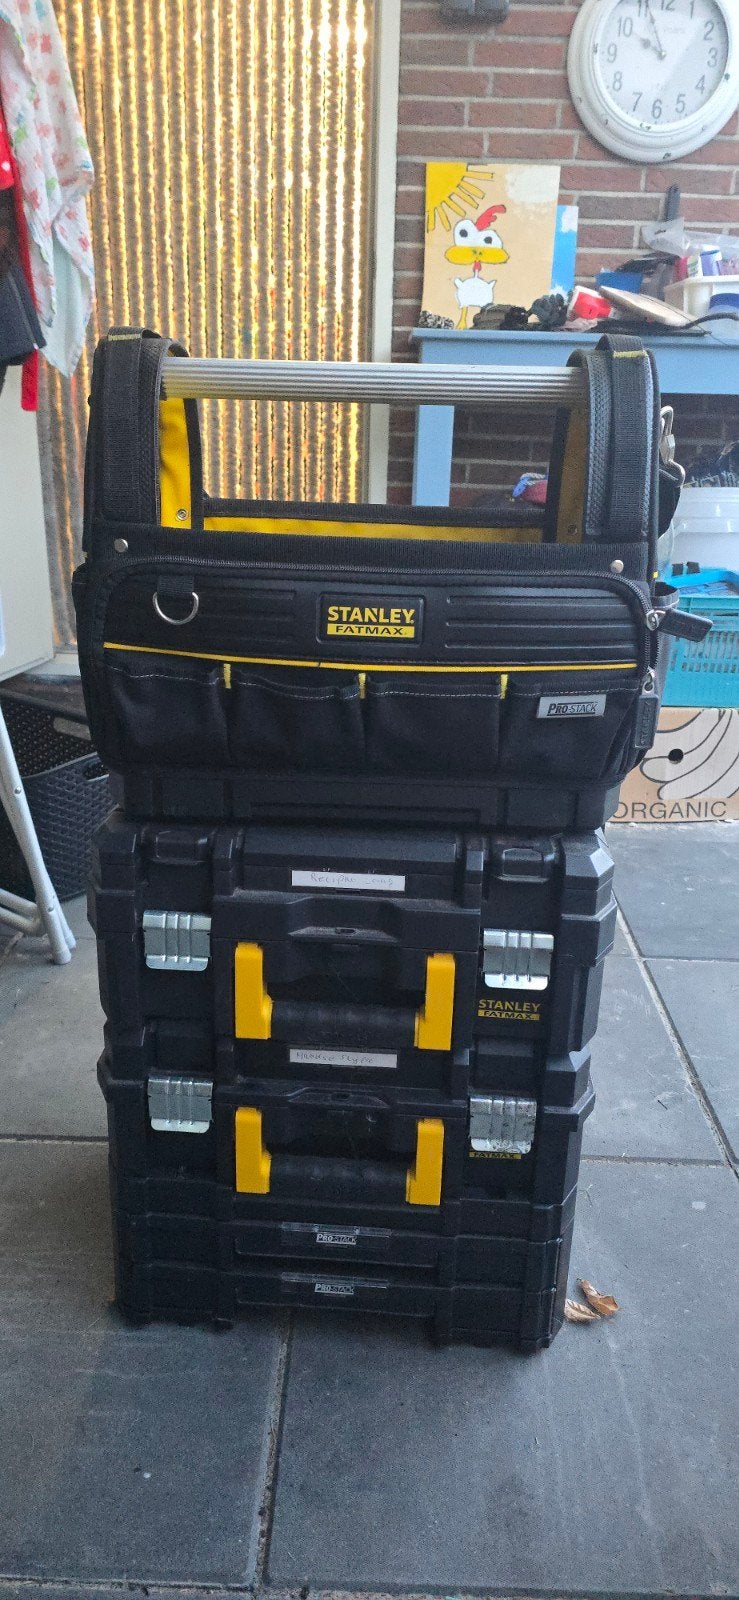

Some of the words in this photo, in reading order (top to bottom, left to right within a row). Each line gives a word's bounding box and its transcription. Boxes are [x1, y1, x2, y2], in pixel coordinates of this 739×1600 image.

[636, 0, 649, 17] 11
[688, 0, 695, 19] 1
[617, 17, 633, 38] 10
[703, 21, 715, 41] 2
[606, 43, 618, 63] 9
[707, 47, 718, 68] 3
[612, 71, 623, 92] 8
[694, 74, 706, 95] 4
[632, 91, 643, 112] 7
[651, 99, 662, 119] 6
[675, 93, 686, 114] 5
[327, 605, 415, 624] STANLEY
[335, 625, 403, 636] FATMAX
[613, 800, 727, 819] ORGANIC
[478, 999, 541, 1012] STANLEY
[483, 1010, 532, 1020] FATMAX
